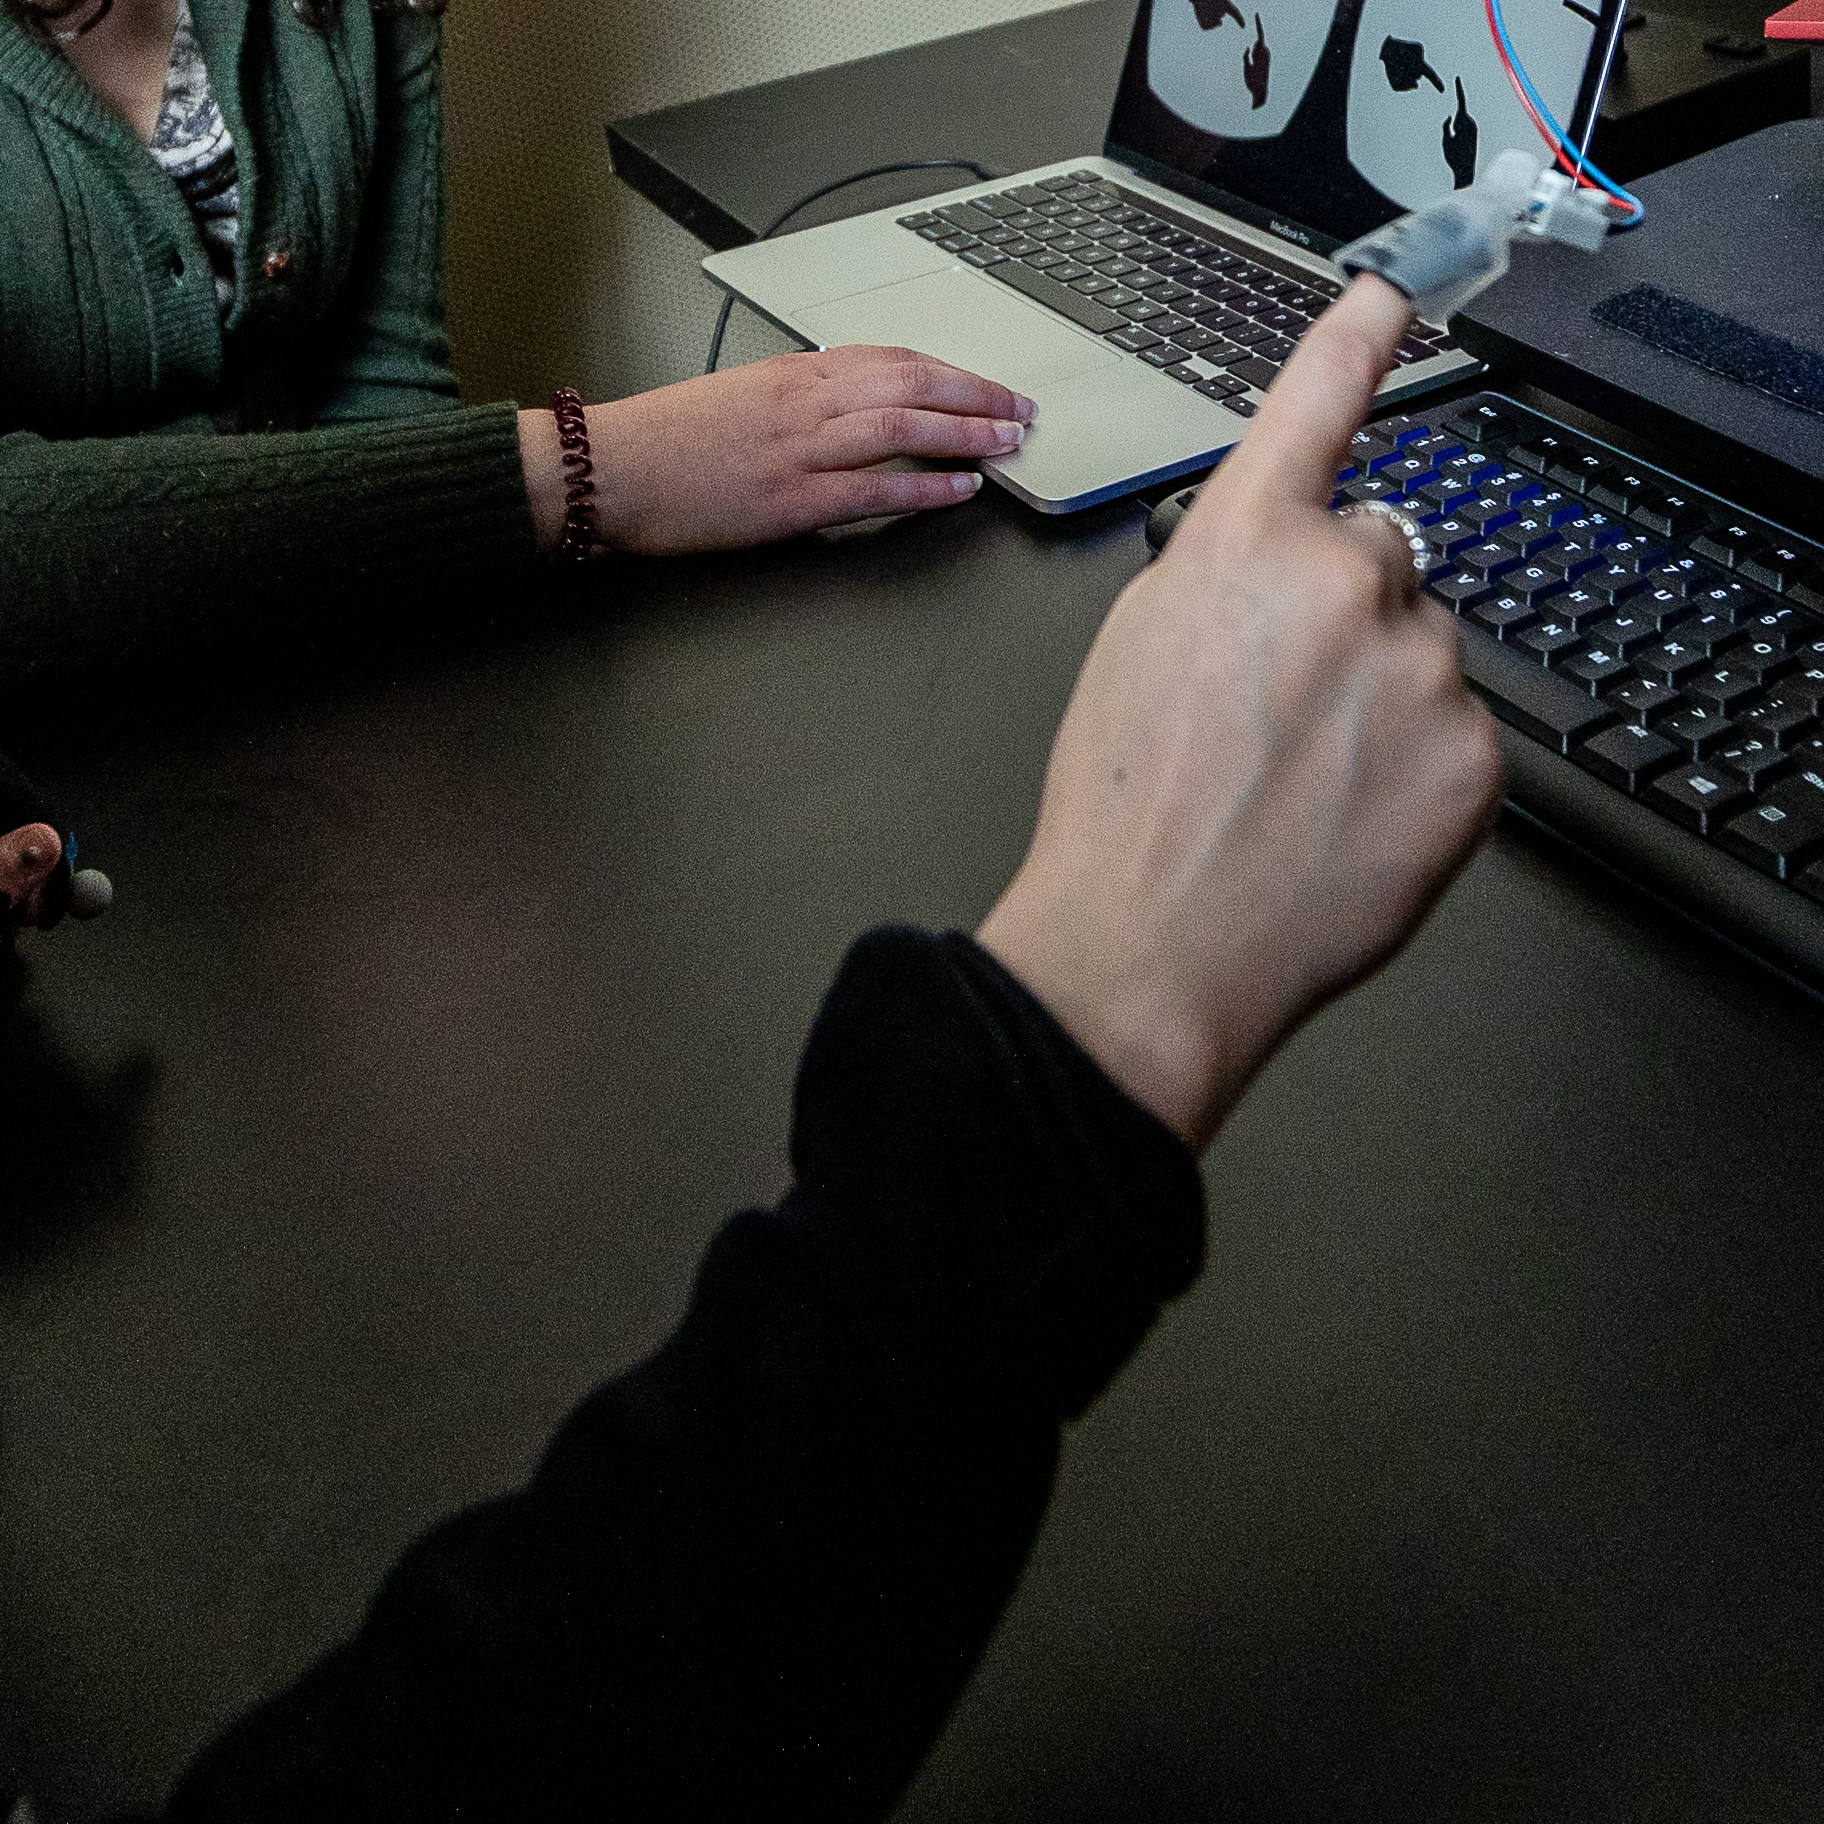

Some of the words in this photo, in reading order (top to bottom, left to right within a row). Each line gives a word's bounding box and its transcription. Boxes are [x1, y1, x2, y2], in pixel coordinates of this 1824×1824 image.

[1270, 220, 1298, 239] MacBook
[1543, 438, 1557, 446] F1
[1468, 454, 1485, 463] @
[1583, 457, 1598, 465] F2
[1404, 460, 1420, 469] Q
[1442, 479, 1461, 489] W
[1625, 477, 1640, 485] F3
[1365, 482, 1381, 490] A
[1404, 501, 1419, 509] S
[1479, 499, 1496, 508] E
[1667, 497, 1684, 506] F4
[1590, 514, 1606, 524] %
[1442, 522, 1459, 530] D
[1520, 520, 1537, 530] R
[1729, 527, 1747, 536] F5
[1565, 542, 1581, 551] T
[1617, 543, 1632, 551] 6
[1777, 550, 1795, 559] F6
[1679, 560, 1694, 569] &
[1526, 568, 1543, 577] G
[1609, 565, 1625, 574] Y
[1458, 574, 1474, 583] V
[1569, 591, 1589, 602] H
[1654, 590, 1673, 600] U
[1710, 590, 1727, 599] 8
[1498, 598, 1516, 609] B
[1702, 615, 1715, 623] I
[1760, 616, 1777, 624] 9
[1542, 624, 1562, 636] N
[1664, 643, 1684, 655] K
[1754, 643, 1772, 653] O
[1588, 651, 1610, 664] M
[1715, 671, 1728, 682] L
[1806, 670, 1824, 679] P
